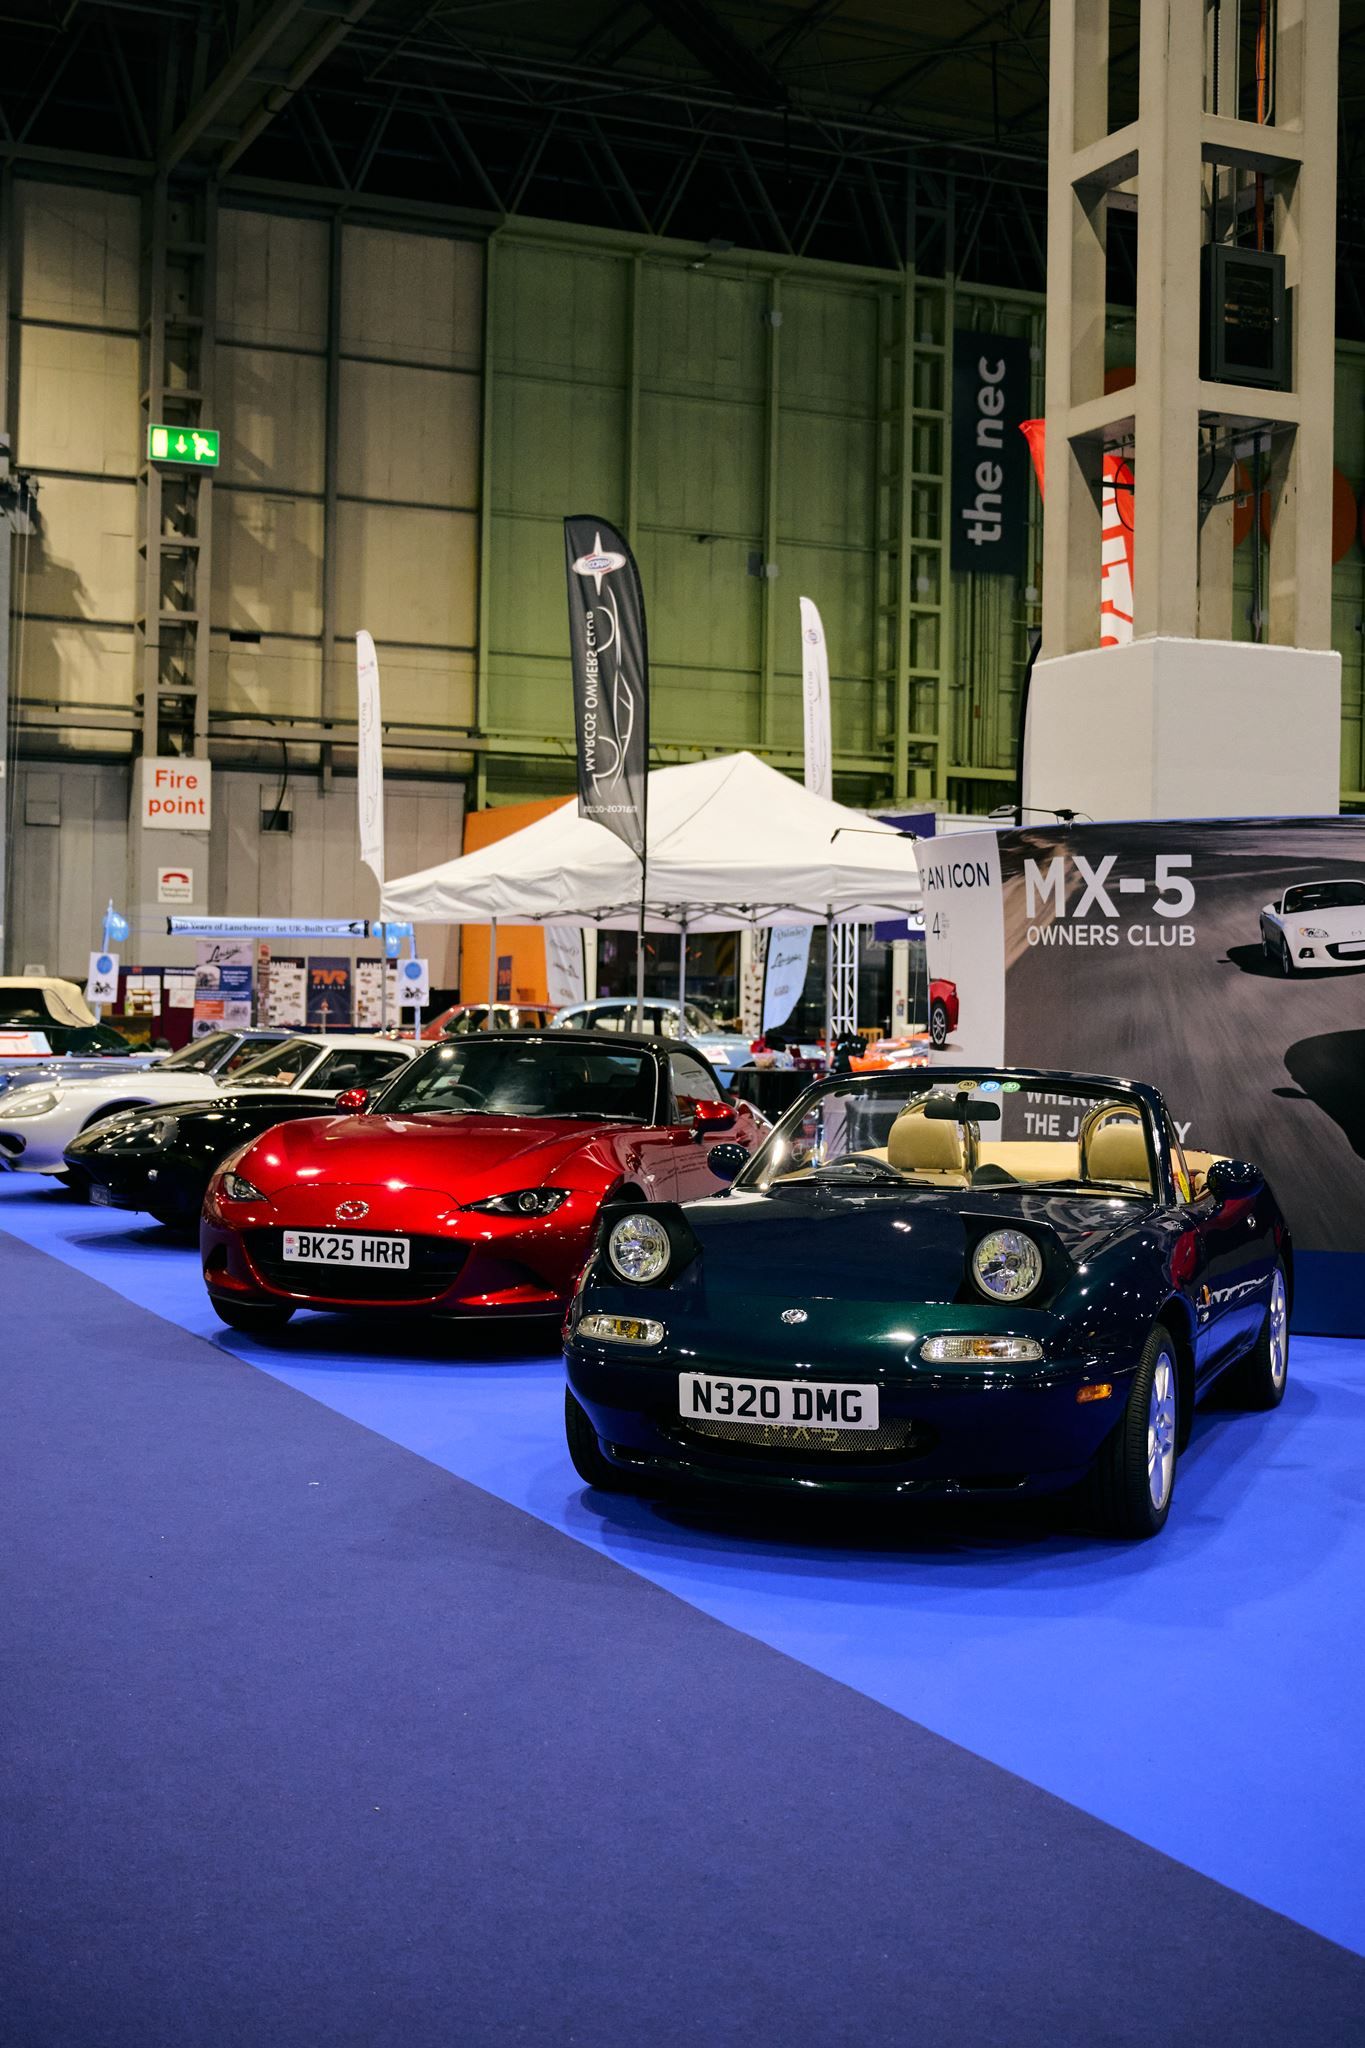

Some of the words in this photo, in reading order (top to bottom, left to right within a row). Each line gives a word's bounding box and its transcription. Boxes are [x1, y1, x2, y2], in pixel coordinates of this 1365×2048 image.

[976, 355, 1007, 449] nec
[962, 461, 1003, 546] the
[155, 769, 198, 790] Fire
[148, 795, 205, 816] point
[927, 864, 945, 891] AN
[947, 861, 990, 889] ICON
[1023, 854, 1196, 918] MX-5
[191, 923, 213, 931] Years
[224, 923, 269, 932] Lanchester
[932, 911, 941, 941] 4
[1026, 924, 1120, 946] OWNERS
[1127, 924, 1196, 947] CLUB
[311, 969, 348, 985] TVR
[1024, 1112, 1061, 1137] THE
[297, 1235, 354, 1261] BK25
[361, 1239, 405, 1265] HRR
[692, 1379, 781, 1419] N320
[792, 1387, 862, 1423] DMG
